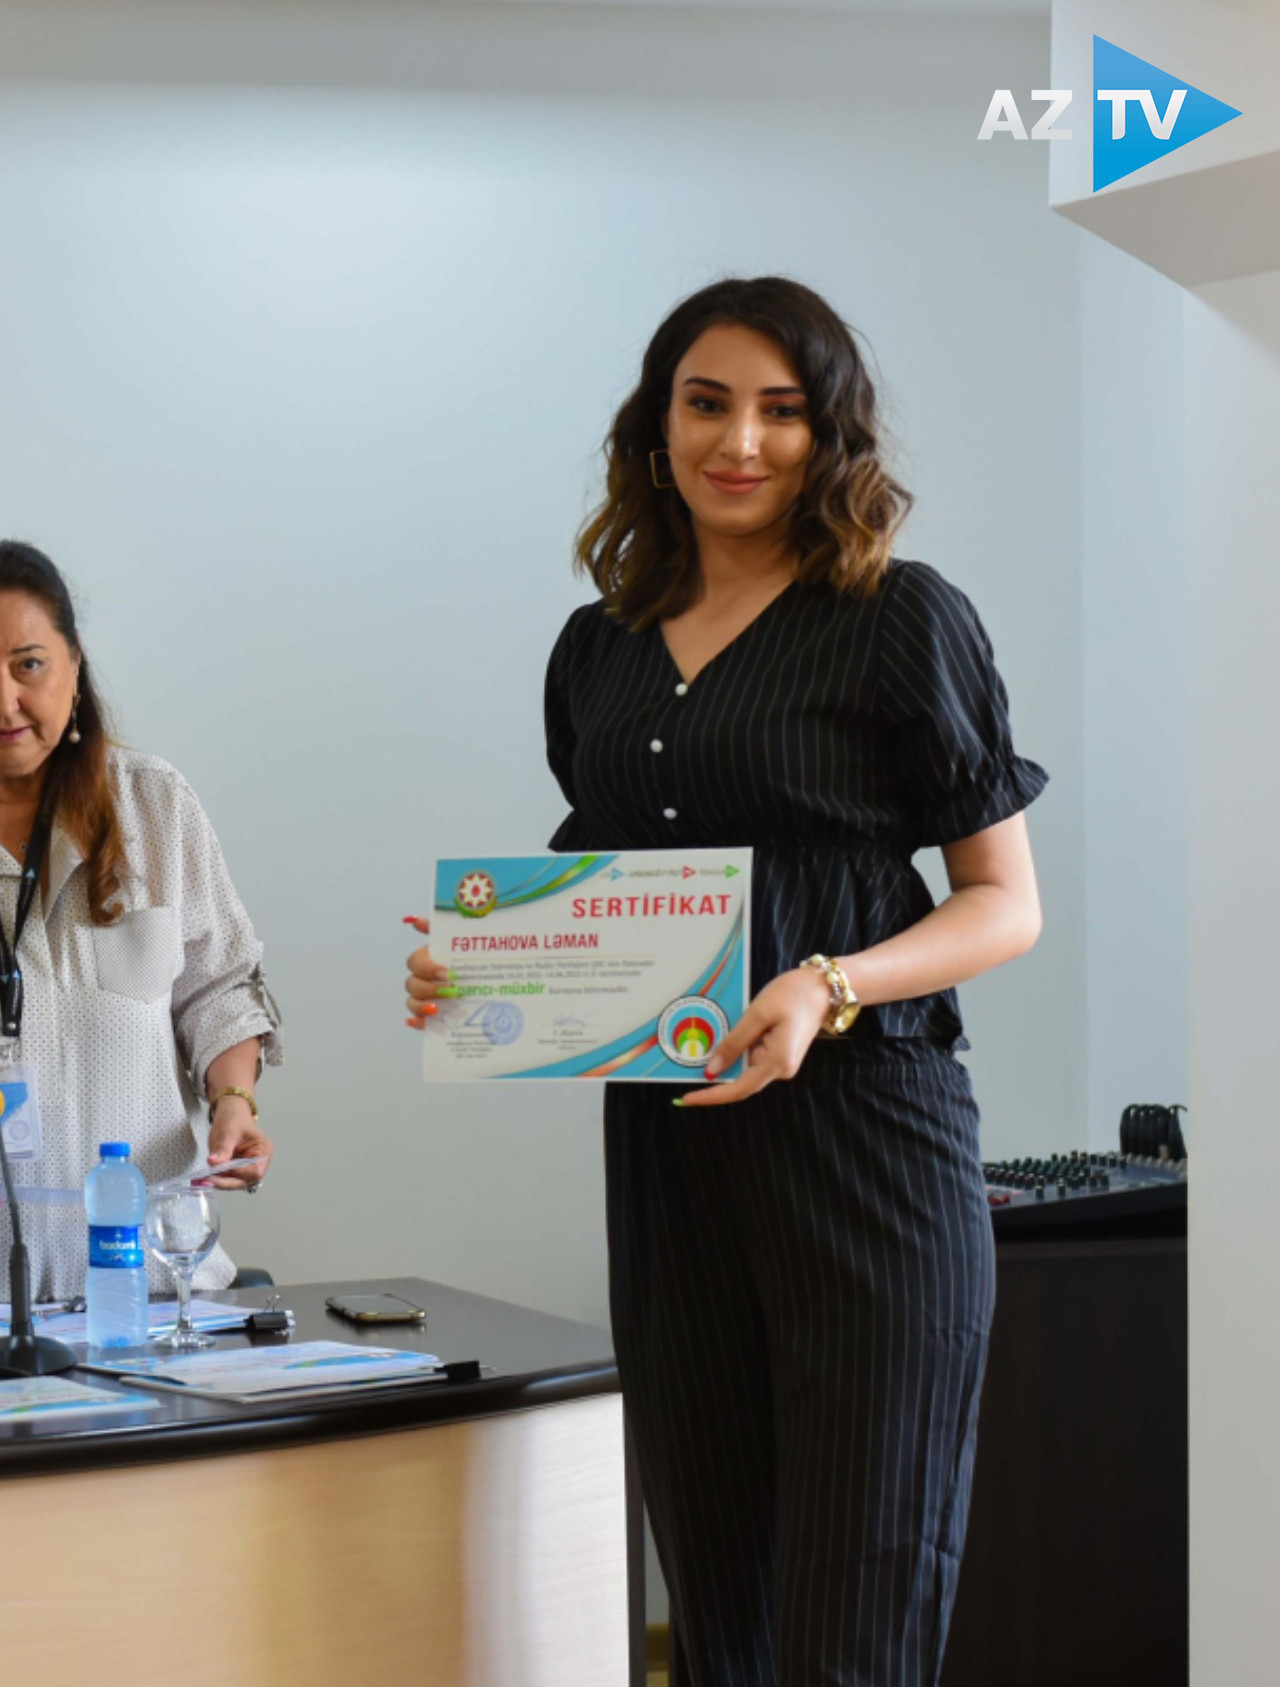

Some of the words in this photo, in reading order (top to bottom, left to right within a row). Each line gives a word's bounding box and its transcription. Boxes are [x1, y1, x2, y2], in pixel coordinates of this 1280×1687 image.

[572, 893, 732, 919] SERTİFİKAT
[451, 934, 539, 951] FƏTTAHOVA
[543, 933, 599, 949] LƏMAN
